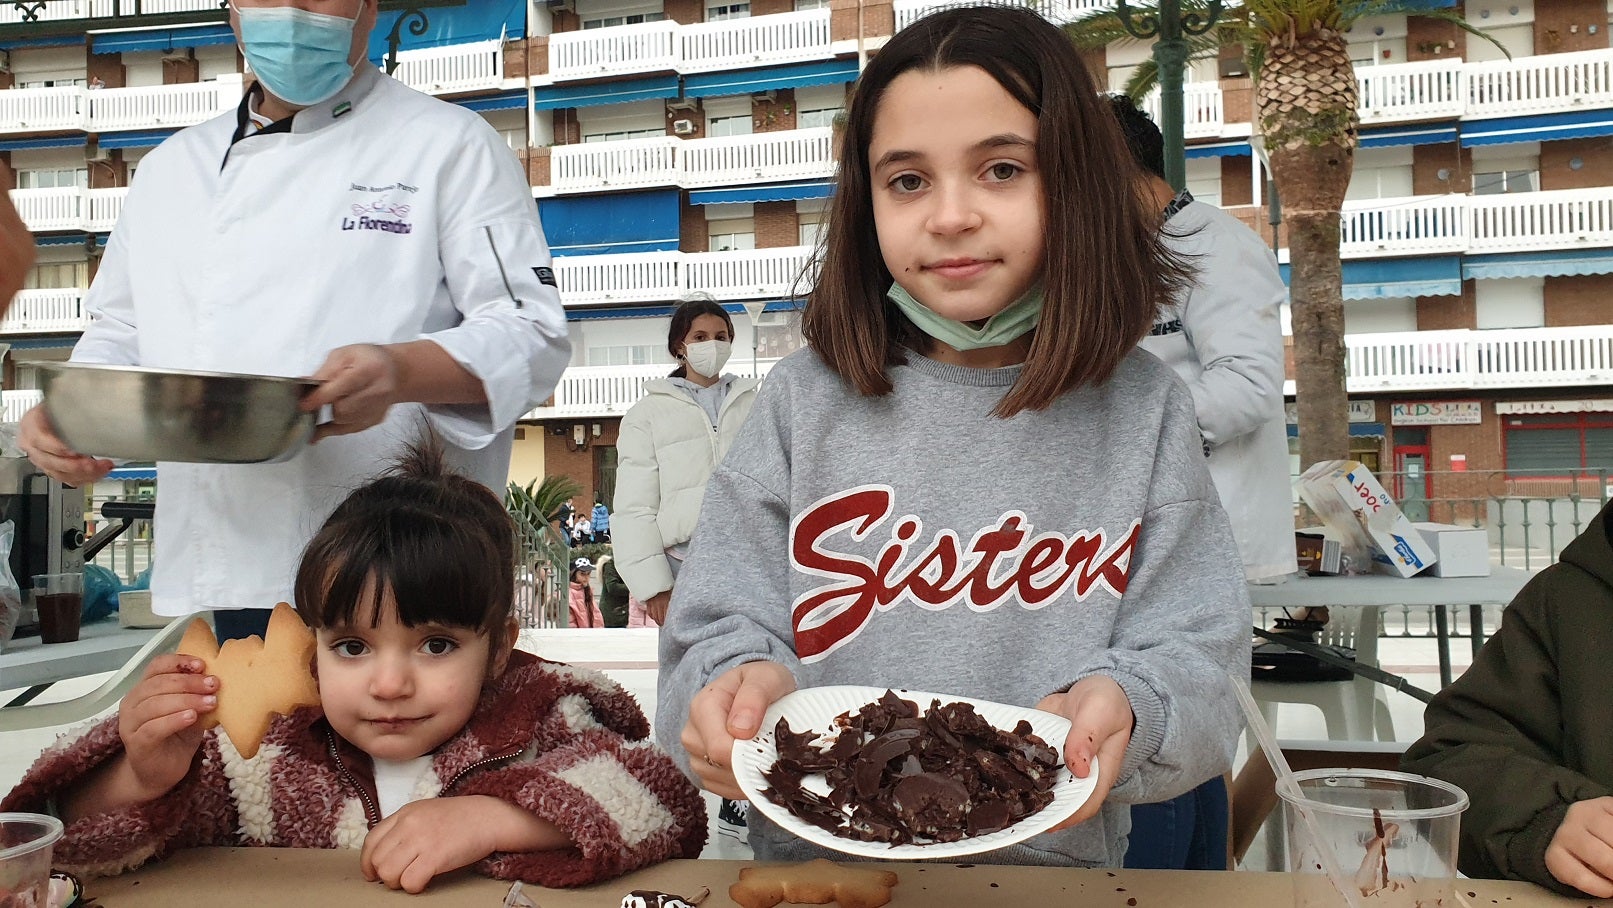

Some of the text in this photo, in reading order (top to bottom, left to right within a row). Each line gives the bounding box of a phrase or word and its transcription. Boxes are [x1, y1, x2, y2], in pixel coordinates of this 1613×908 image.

[342, 217, 355, 231] La
[1393, 403, 1442, 416] KIDS
[789, 484, 1142, 665] Sisters
